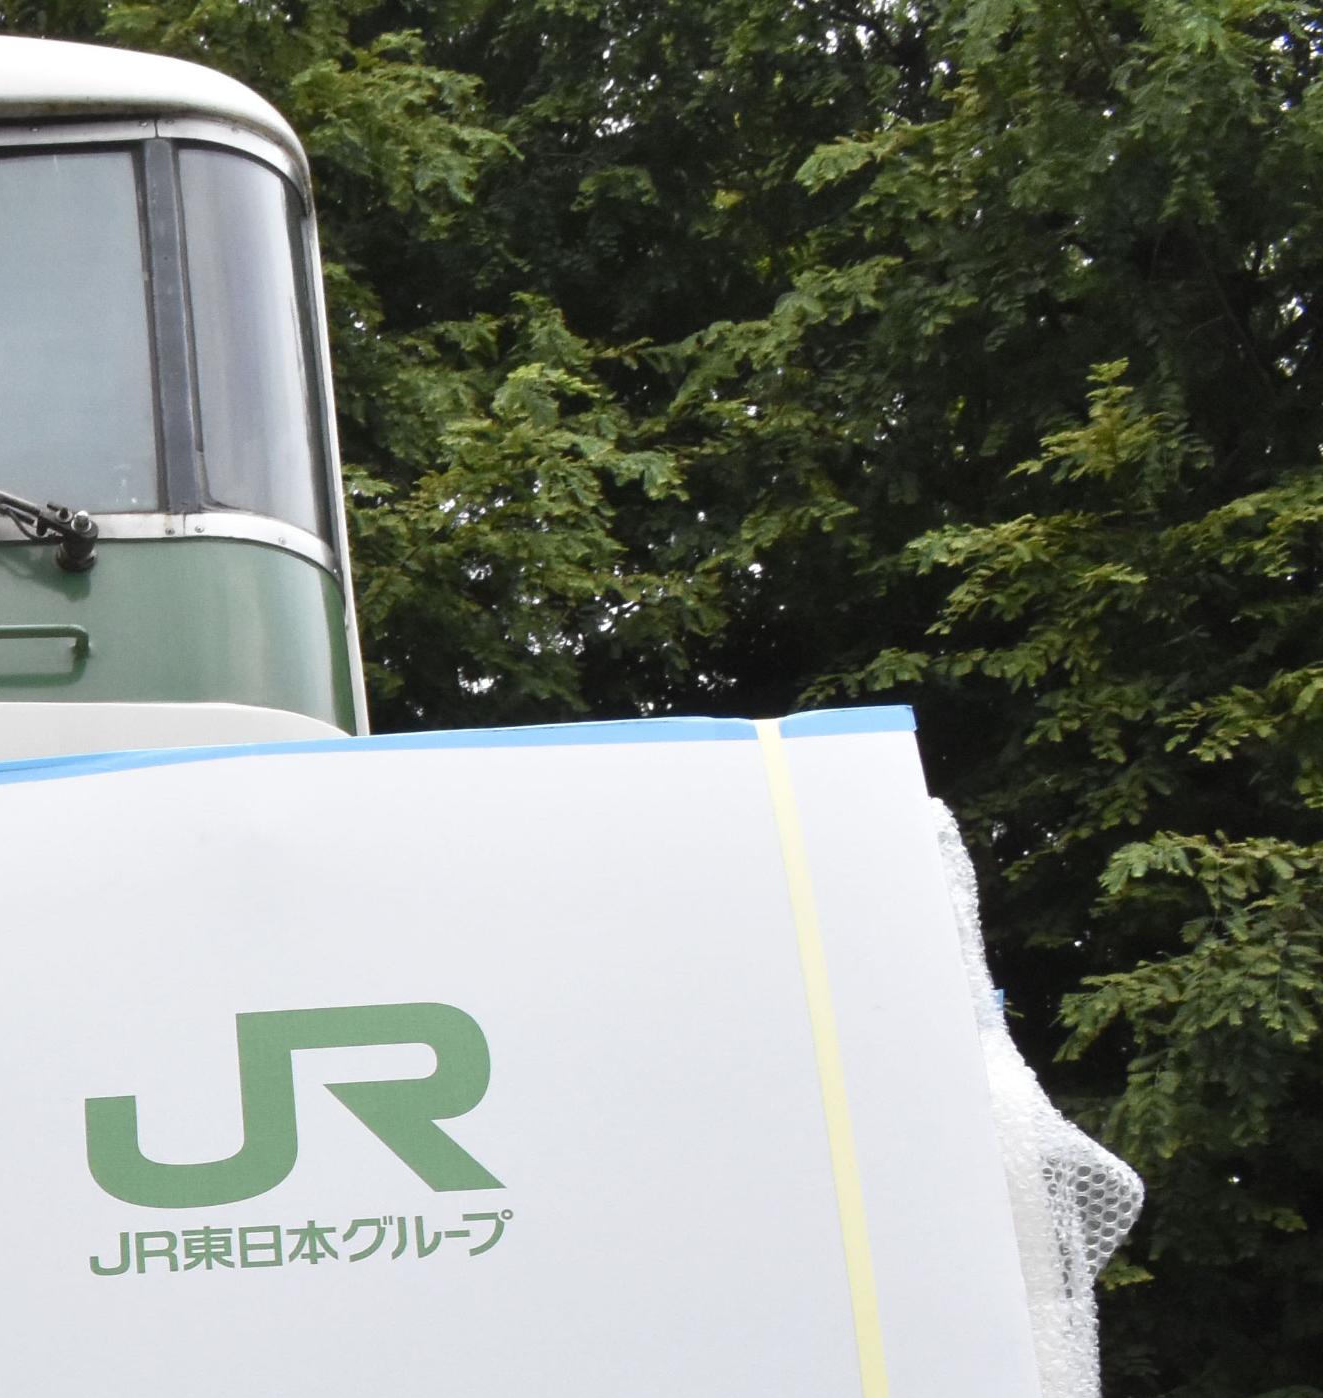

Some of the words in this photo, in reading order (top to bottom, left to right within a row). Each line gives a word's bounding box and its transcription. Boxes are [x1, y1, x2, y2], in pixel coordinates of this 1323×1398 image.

[85, 1002, 507, 1208] JR
[89, 1209, 514, 1277] JR東日本グループ
